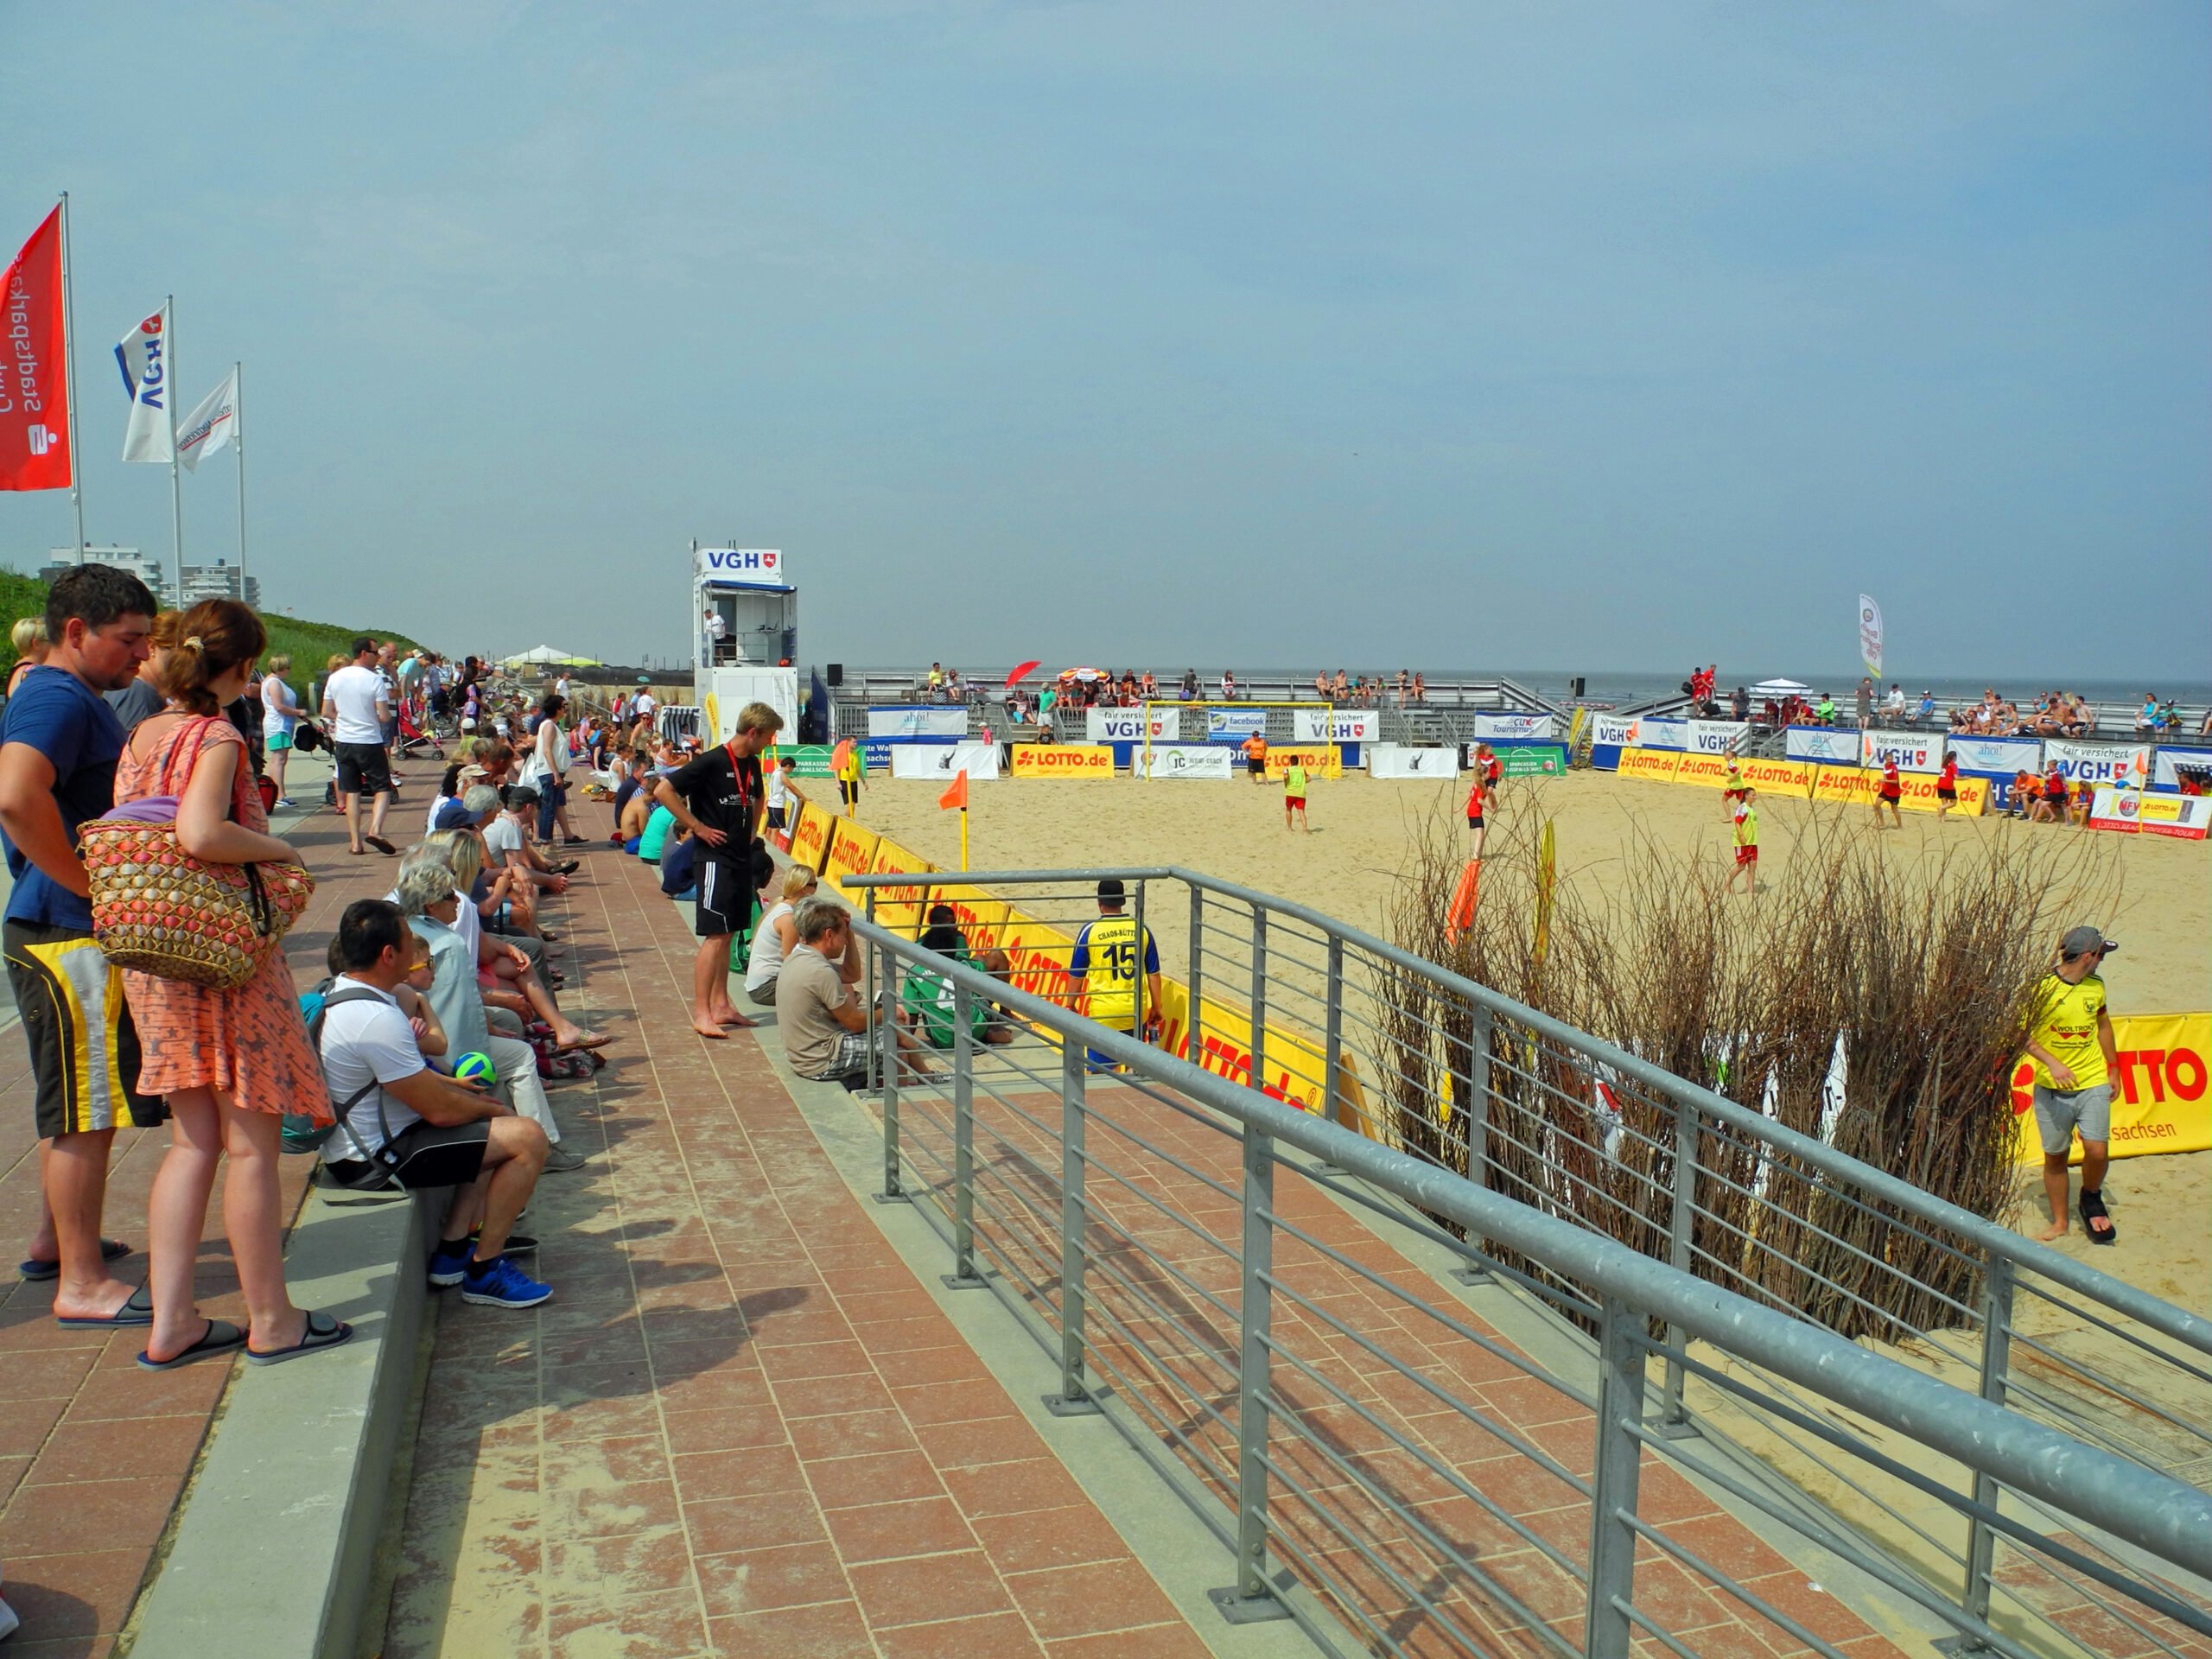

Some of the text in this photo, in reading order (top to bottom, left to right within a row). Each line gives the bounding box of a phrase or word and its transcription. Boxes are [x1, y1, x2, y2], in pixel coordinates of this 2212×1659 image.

[709, 552, 759, 569] VGH
[904, 711, 930, 722] ahoi!
[1230, 716, 1264, 725] facebook
[1105, 722, 1147, 737] VGH
[1311, 724, 1351, 738] VGH
[1600, 728, 1624, 742] VGH
[1699, 734, 1727, 750] VGH
[1876, 735, 1928, 747] fair versichert
[1978, 743, 2003, 756] ahoi!
[2063, 745, 2129, 758] fair versichert
[1037, 753, 1108, 766] LOTTO.de
[1274, 753, 1336, 766] LOTO.de
[1632, 755, 1674, 771] LOTTO.de
[1757, 766, 1809, 785] LOTTO.de
[2063, 760, 2110, 779] VGH
[2119, 800, 2140, 811] NFV
[2151, 803, 2177, 812] LOTTO.de
[1103, 941, 1136, 981] 15
